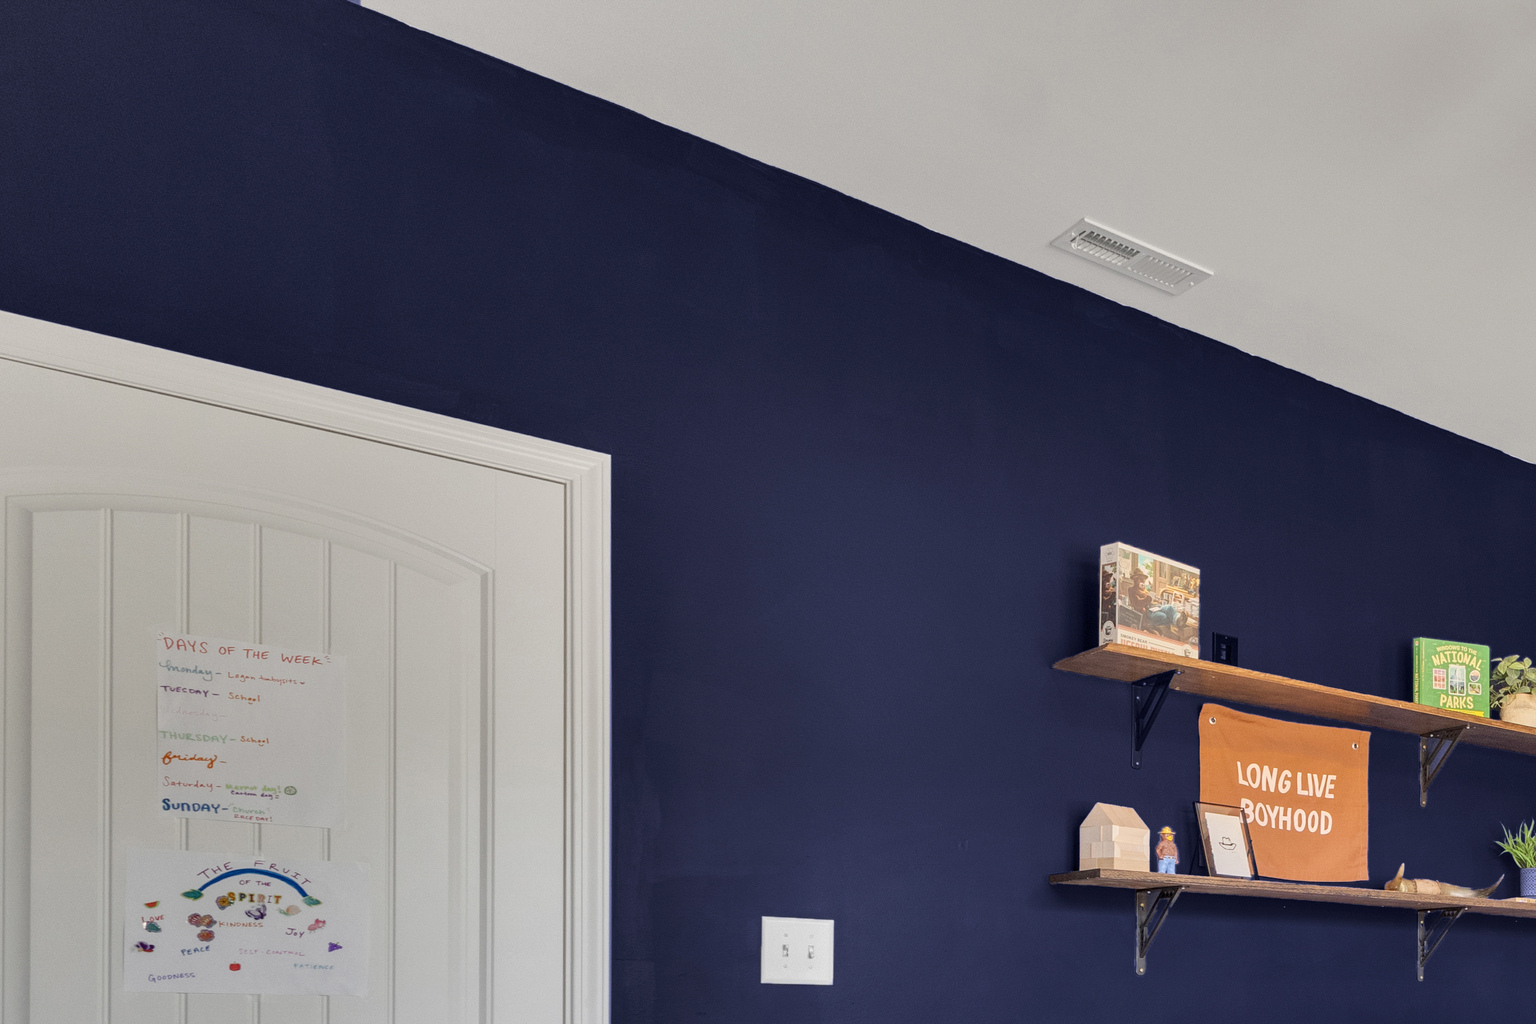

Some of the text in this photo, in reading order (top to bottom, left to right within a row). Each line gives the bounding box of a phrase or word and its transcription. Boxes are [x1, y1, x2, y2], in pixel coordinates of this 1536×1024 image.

[163, 637, 323, 665] DAYS OF THE WEEK
[1432, 651, 1482, 671] NATIONAL
[228, 672, 256, 682] Logan
[228, 692, 261, 704] School
[1440, 694, 1474, 709] PARKS
[158, 730, 228, 744] THURSDAY
[240, 735, 270, 747] School
[162, 776, 213, 792] Saturday
[1236, 761, 1337, 798] LONG LIVE
[162, 798, 221, 814] SUNDAY
[1240, 798, 1333, 835] BOYHOOD
[197, 860, 312, 886] THE FRUIT
[227, 892, 283, 905] SPIRIT
[141, 914, 165, 923] LOVE
[219, 920, 264, 928] KINDNESS
[181, 945, 211, 956] PEACE
[293, 962, 335, 970] PATIENCE
[148, 972, 196, 983] GOODNESS
